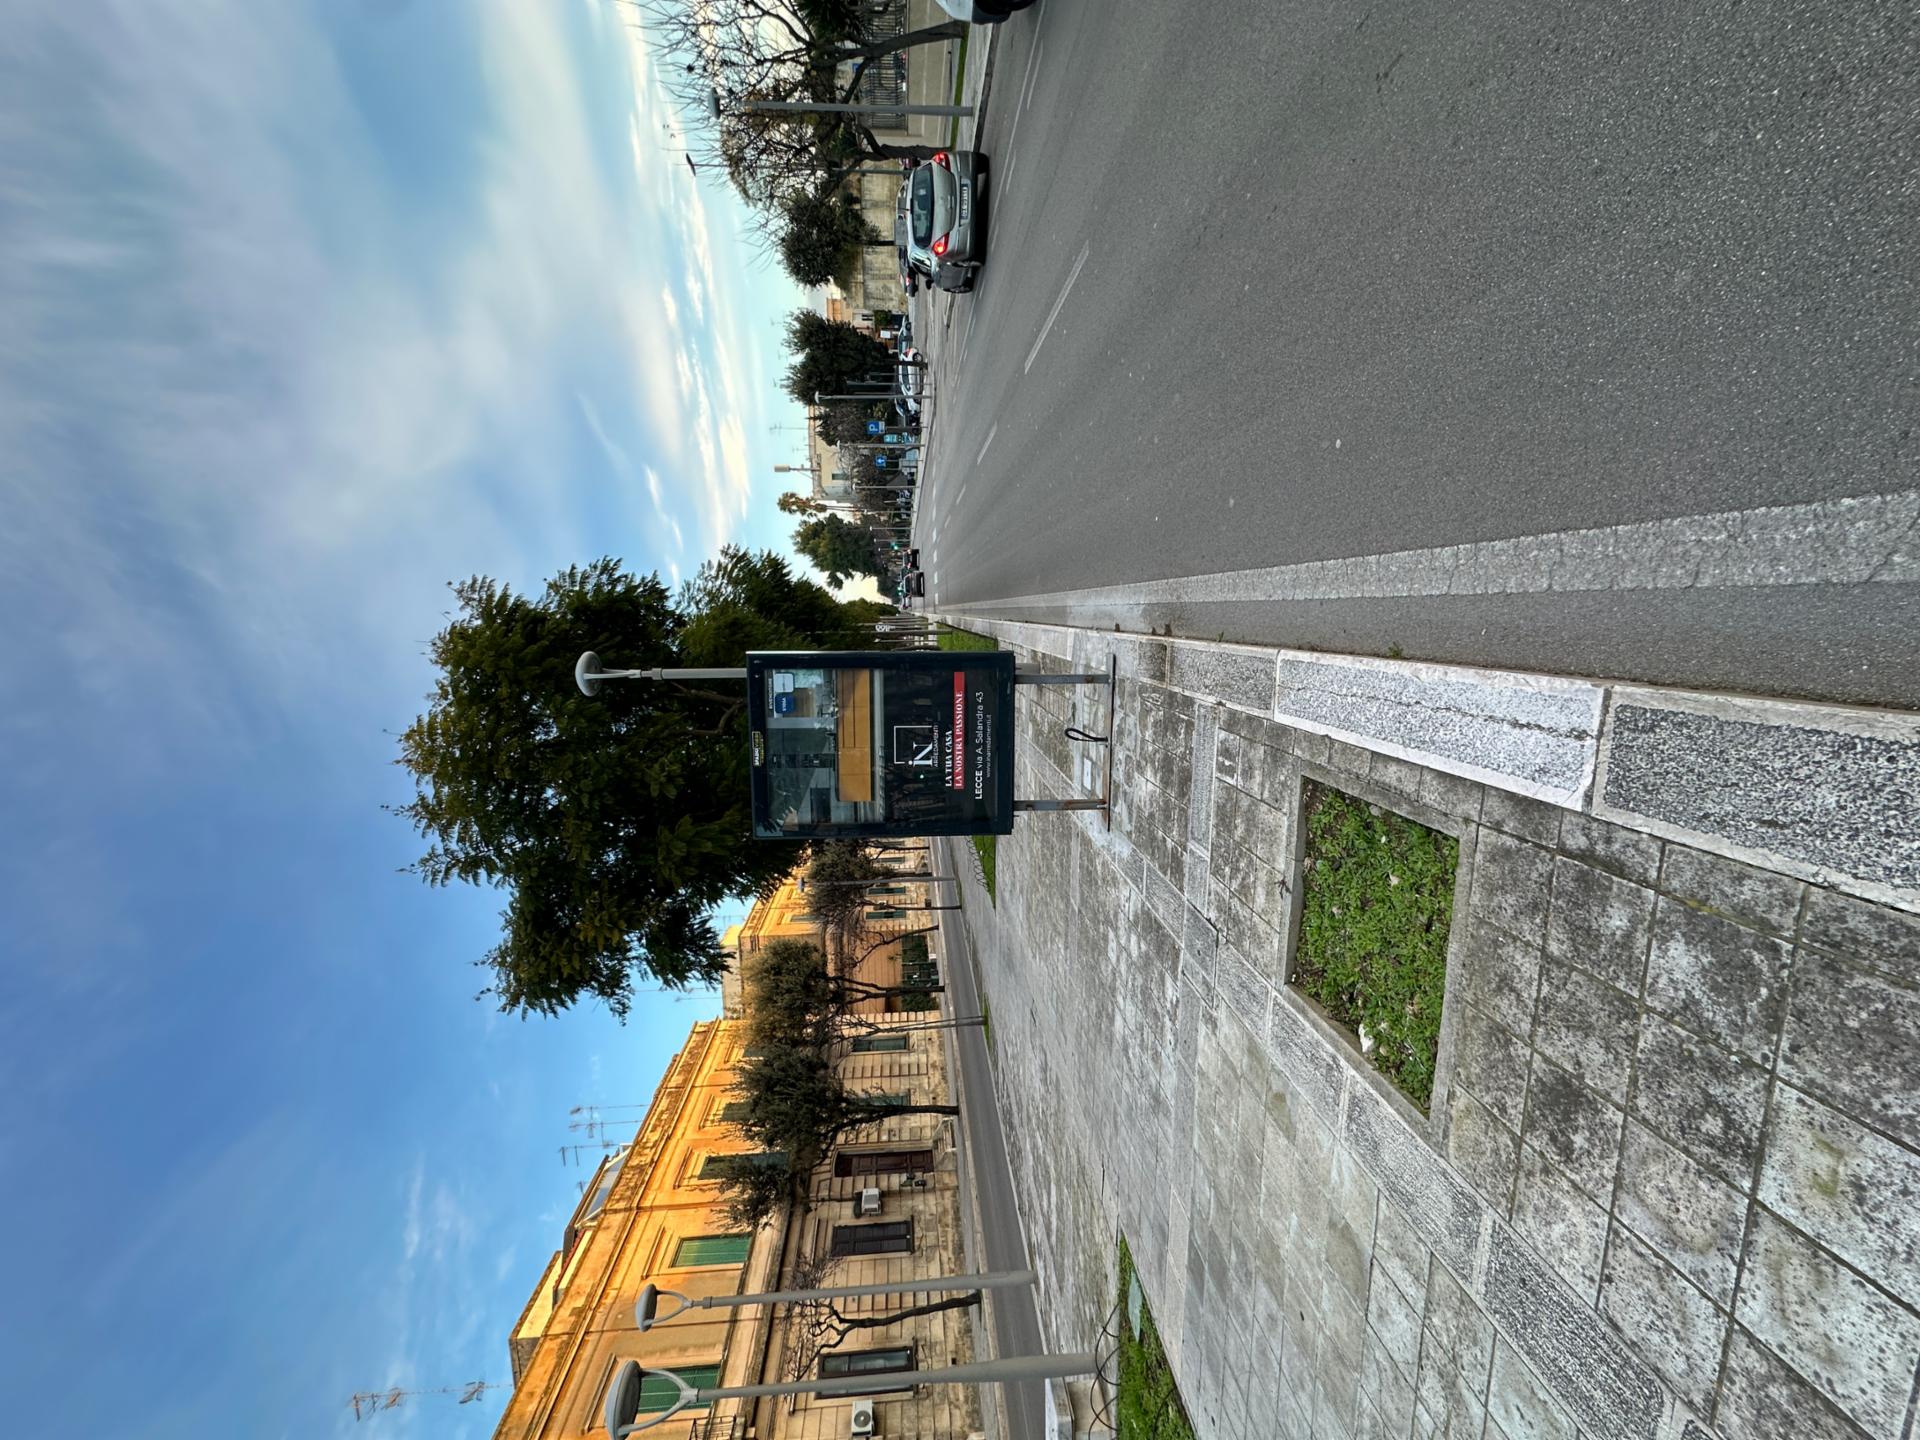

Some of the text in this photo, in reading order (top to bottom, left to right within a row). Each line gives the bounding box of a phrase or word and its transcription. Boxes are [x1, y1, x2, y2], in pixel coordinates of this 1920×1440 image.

[869, 424, 878, 432] P
[975, 691, 983, 703] 43
[955, 691, 963, 735] PASSIONE
[975, 704, 983, 744] Salandra
[945, 730, 953, 752] CASA
[975, 745, 983, 754] A.
[975, 756, 983, 769] via
[945, 776, 952, 787] LA
[955, 776, 962, 787] LA
